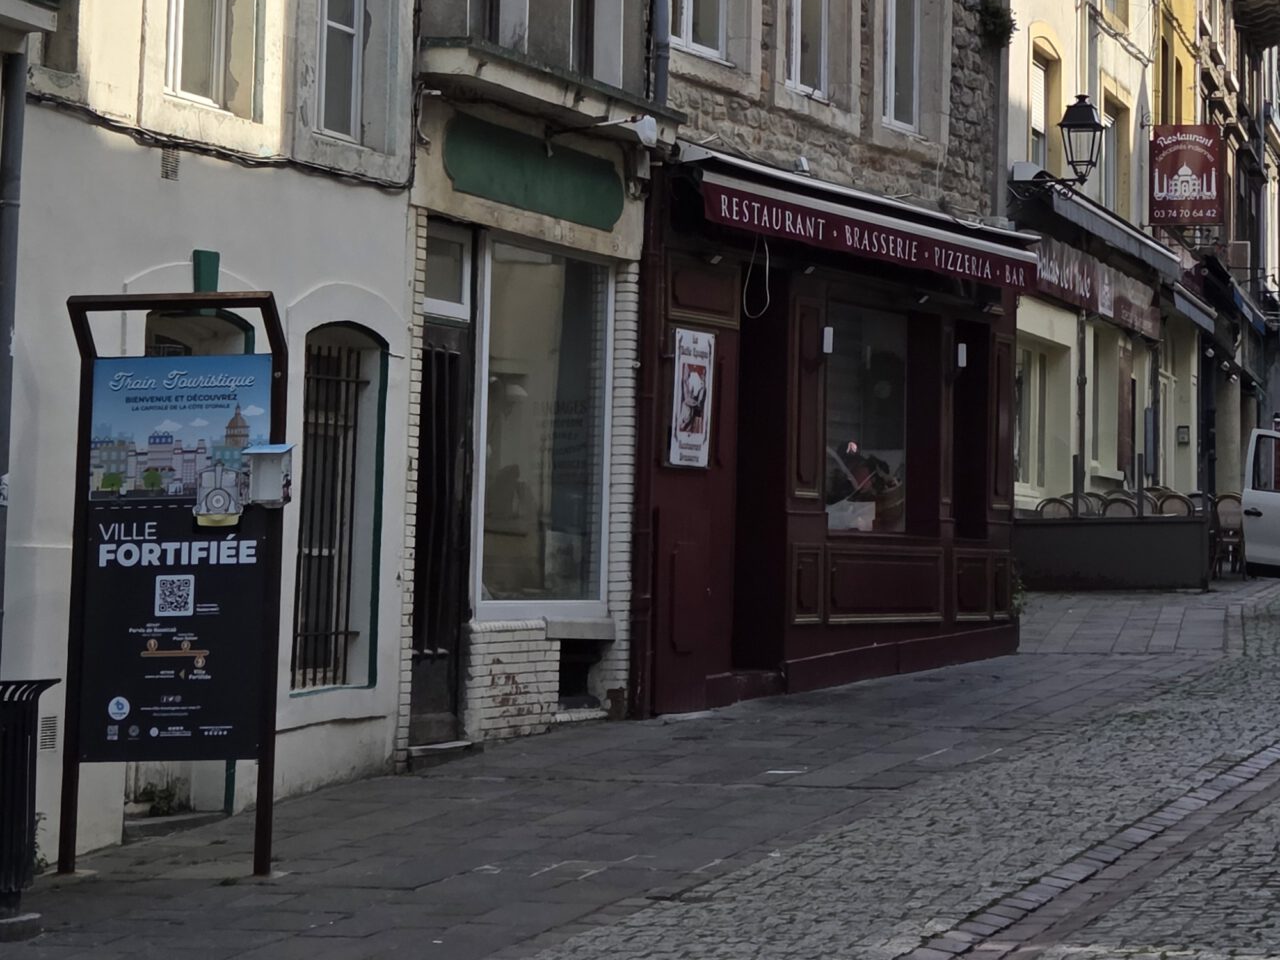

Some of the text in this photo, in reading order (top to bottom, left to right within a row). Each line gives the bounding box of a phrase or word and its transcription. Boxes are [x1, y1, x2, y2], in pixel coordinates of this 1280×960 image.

[1154, 209, 1217, 218] 03 74 70 64 42
[720, 194, 1026, 288] RESTAURANT BRASSERIE PIZZERIA BAR
[109, 370, 256, 393] Train Touristique
[125, 396, 172, 404] BIENVENUE
[186, 393, 238, 402] DÉCOUVREZ
[98, 522, 157, 541] VILLE
[98, 534, 257, 567] FORTIFIÉE
